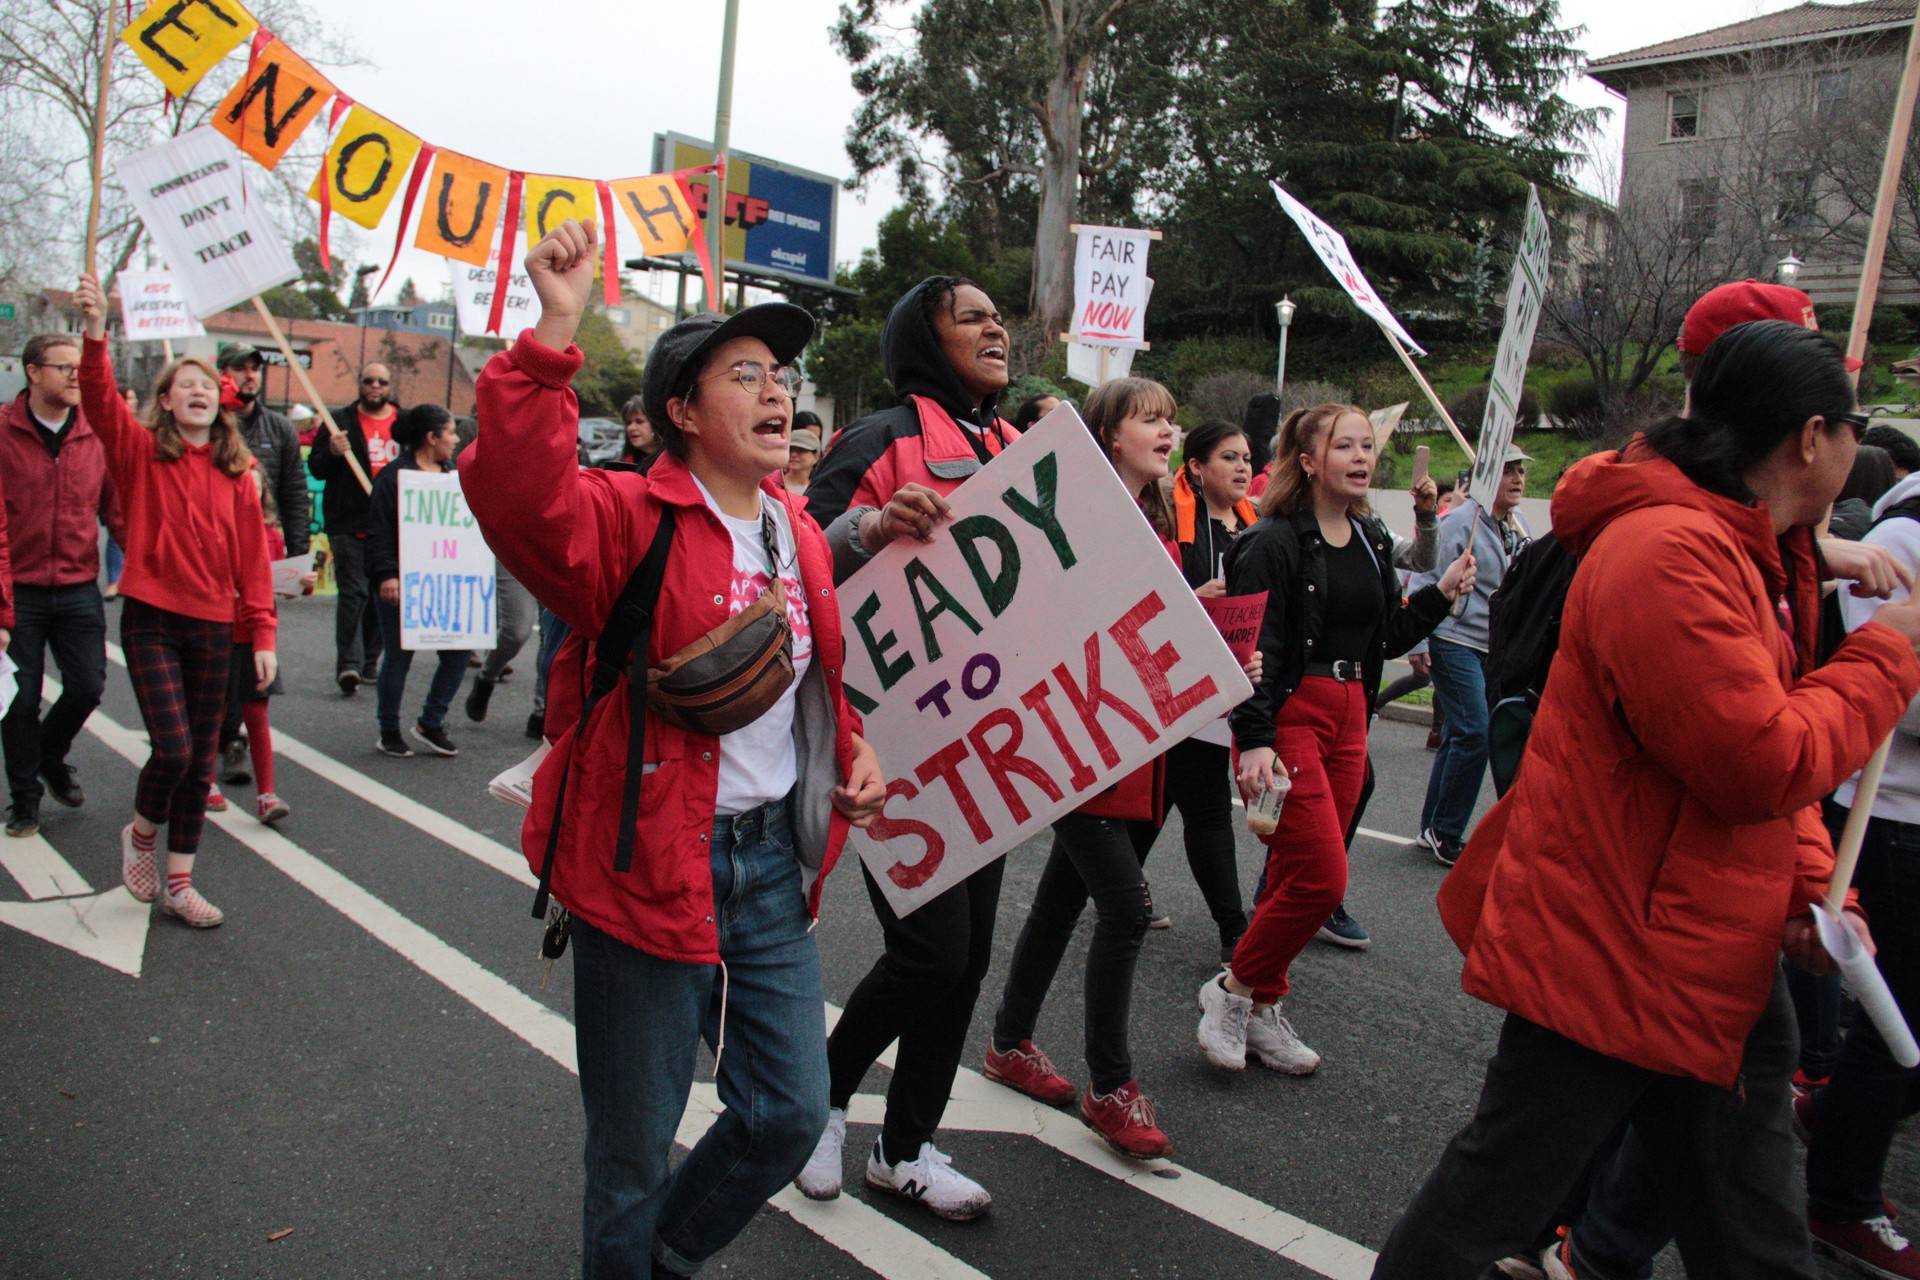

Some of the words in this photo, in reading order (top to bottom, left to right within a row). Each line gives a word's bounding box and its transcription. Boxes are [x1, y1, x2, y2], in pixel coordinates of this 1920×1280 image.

[150, 159, 230, 198] CONSULTANTS
[180, 196, 231, 229] DON'T
[195, 230, 253, 264] TEACH
[1091, 235, 1135, 264] FAIR
[468, 268, 528, 287] DESVE
[1091, 270, 1130, 298] PAY
[1082, 301, 1137, 331] NOW
[432, 539, 457, 560] IN
[403, 571, 495, 635] EQUITY
[915, 652, 1001, 719] TO
[866, 589, 1220, 890] STRIKE
